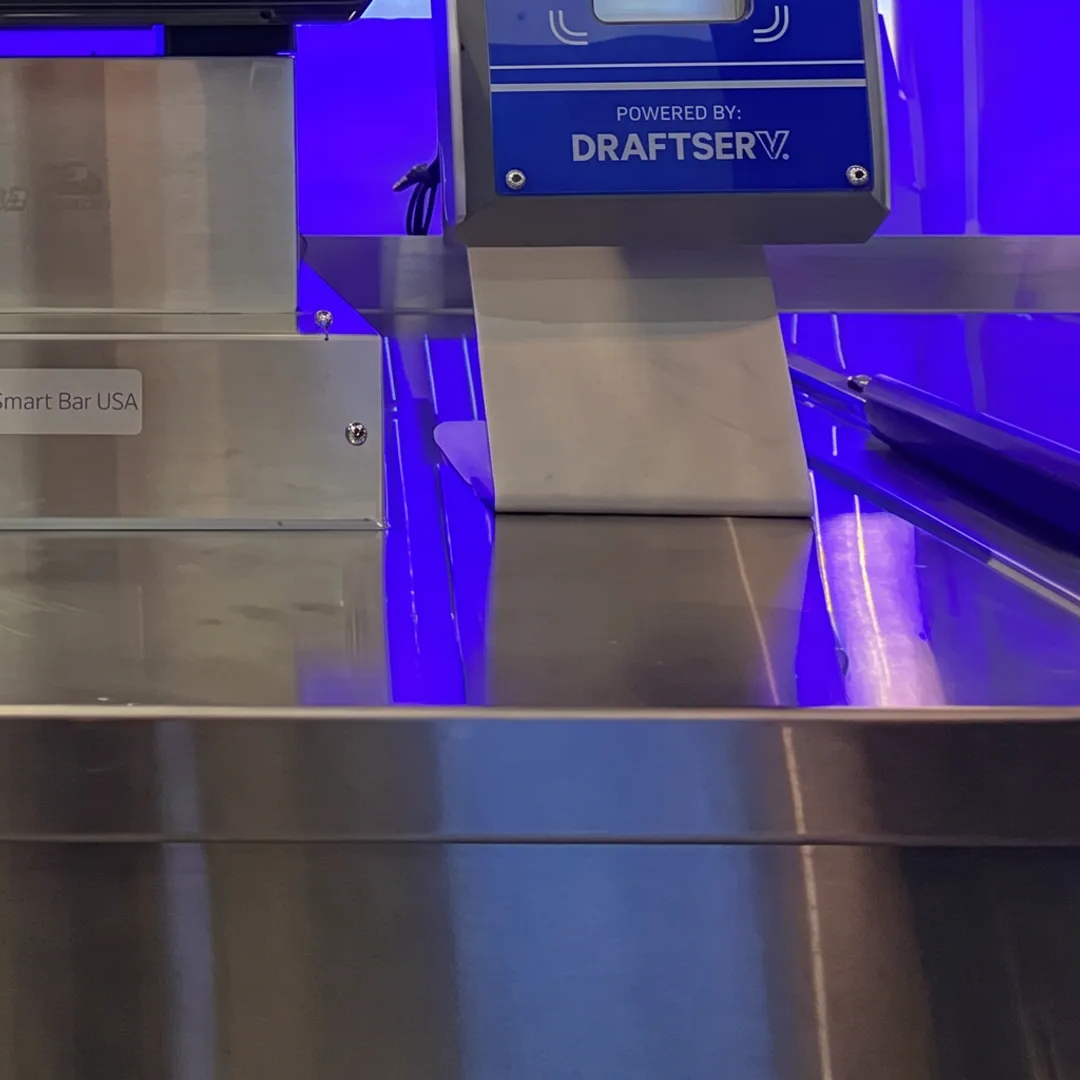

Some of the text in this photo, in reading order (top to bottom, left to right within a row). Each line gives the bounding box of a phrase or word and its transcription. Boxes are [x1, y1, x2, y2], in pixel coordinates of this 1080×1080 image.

[616, 104, 742, 122] POWERED BY:
[58, 392, 92, 411] Bar
[96, 392, 139, 411] USA
